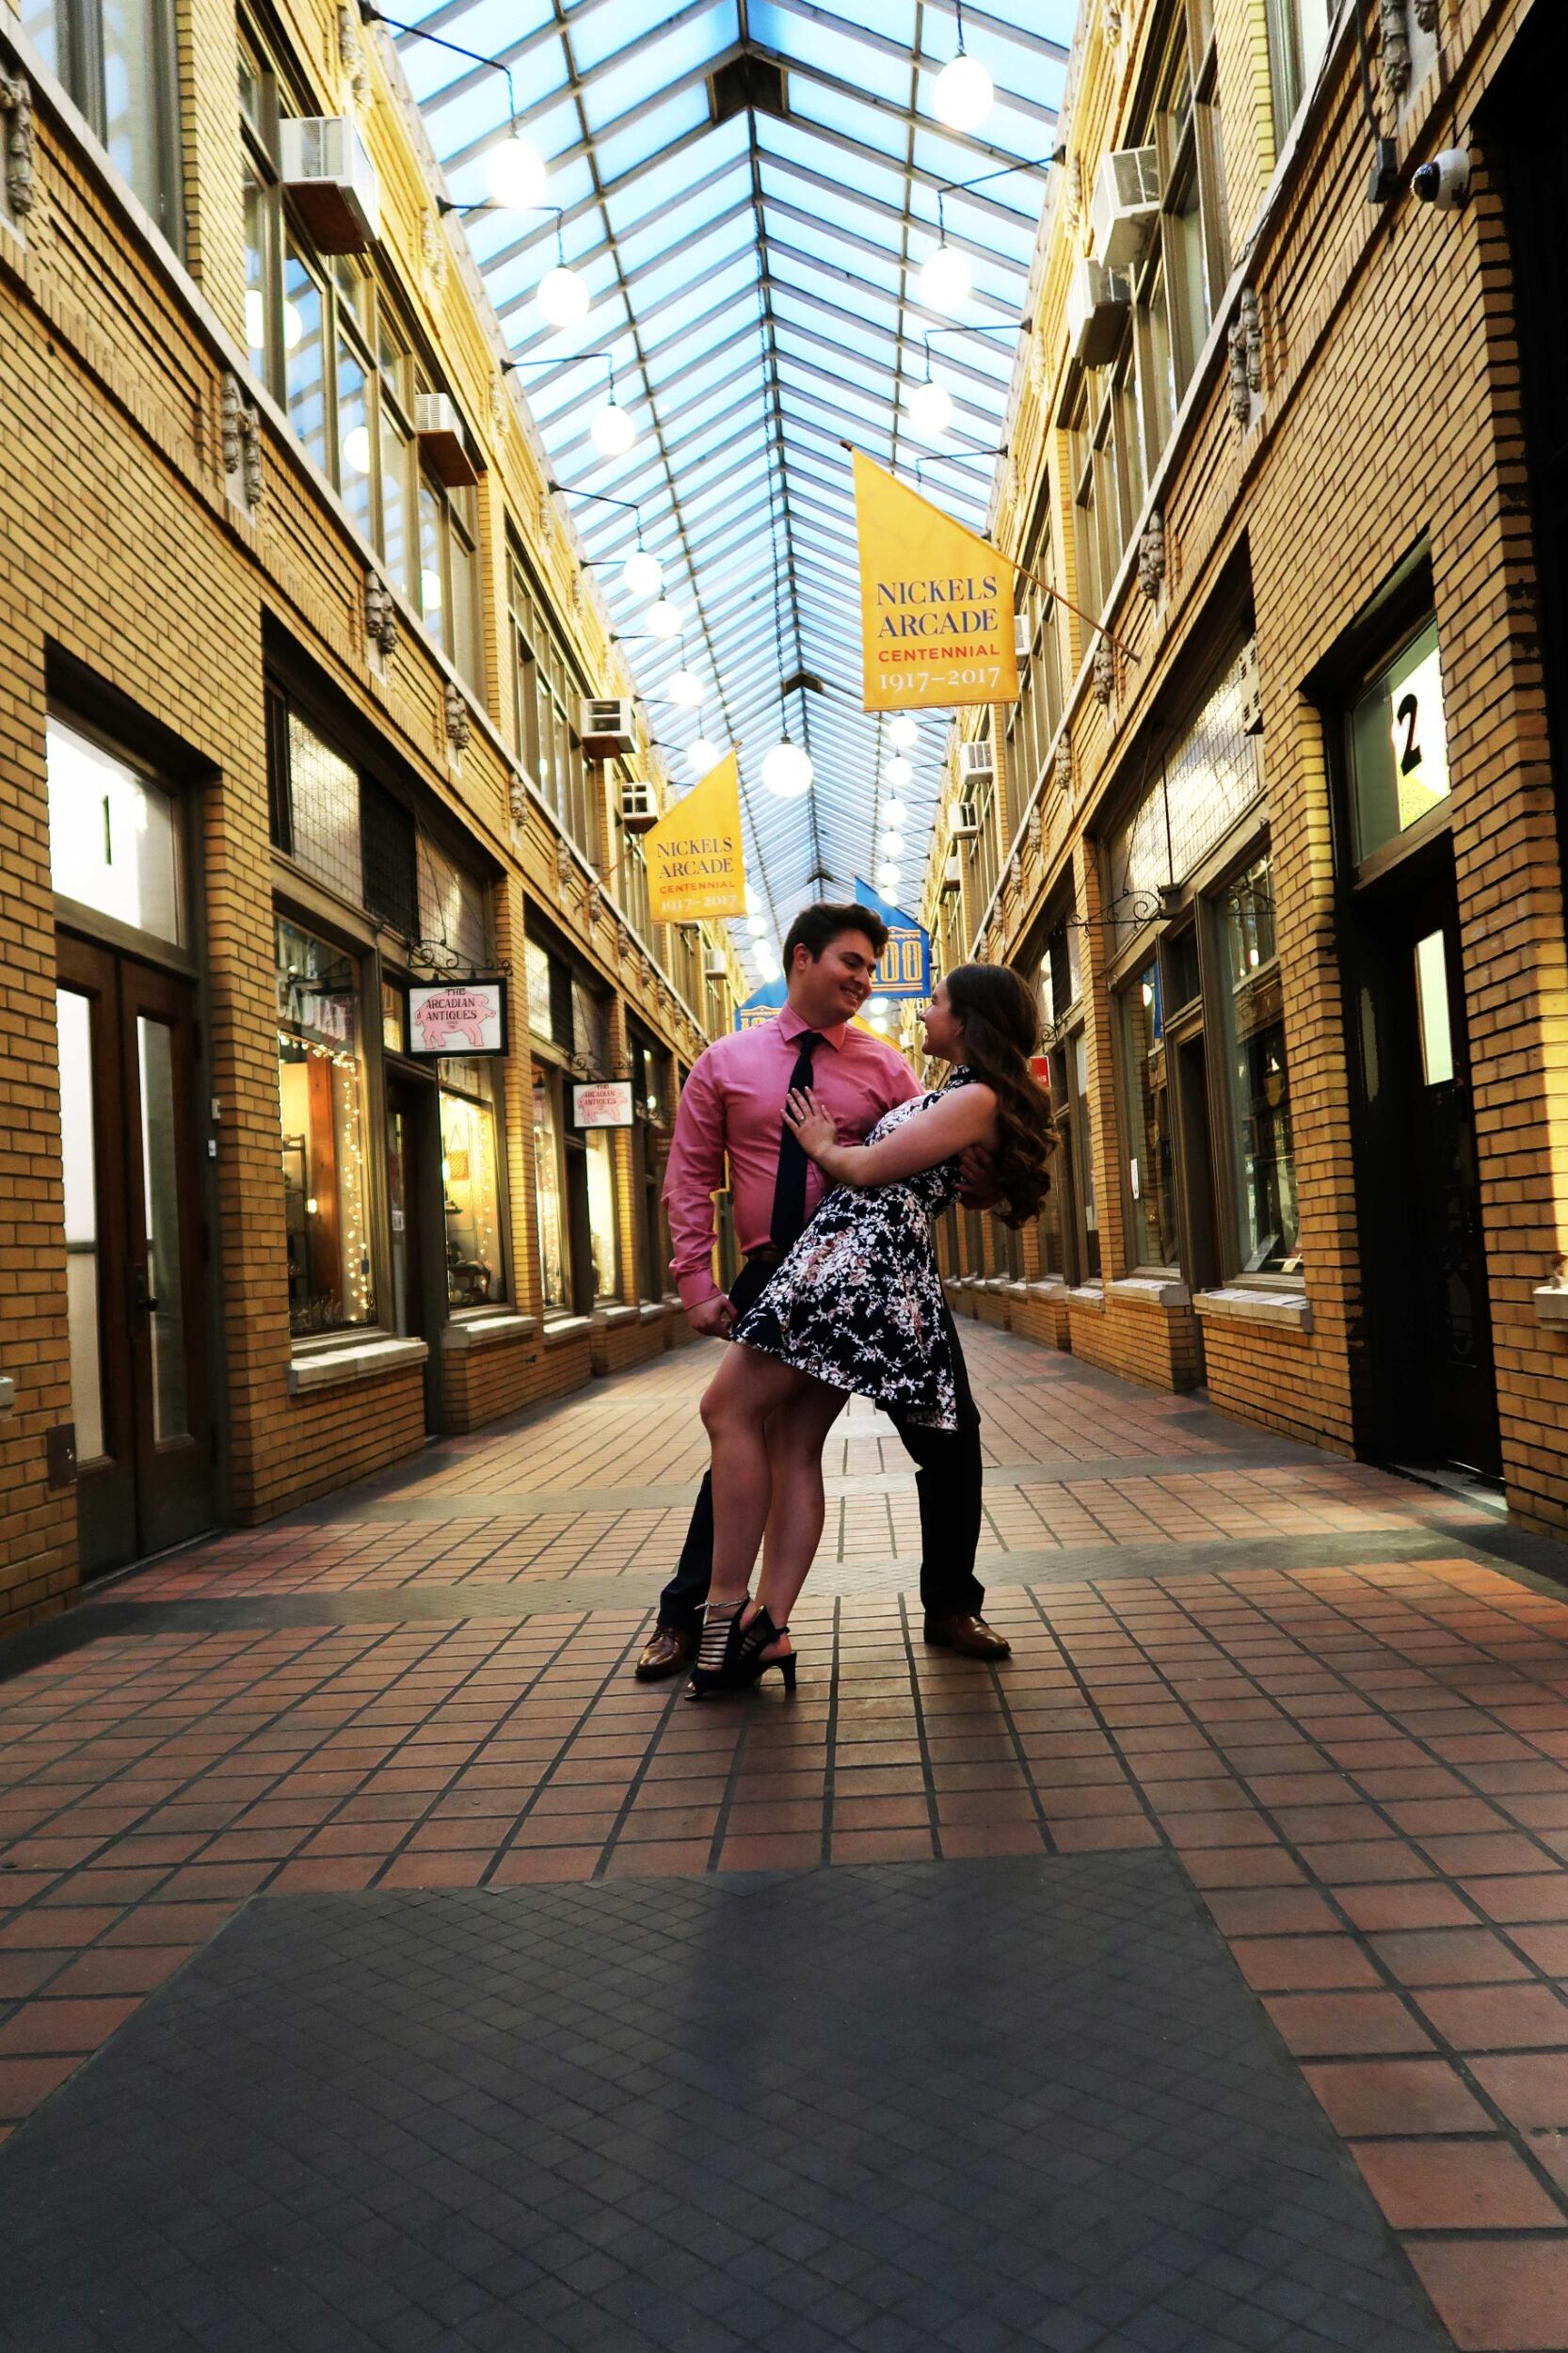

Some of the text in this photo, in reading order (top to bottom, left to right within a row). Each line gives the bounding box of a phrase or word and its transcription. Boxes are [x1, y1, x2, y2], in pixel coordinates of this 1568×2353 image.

[876, 575, 998, 605] NICKELS
[877, 608, 999, 638] ARCADE
[878, 644, 1000, 663] CENTENNIAL
[1397, 694, 1422, 776] 2
[657, 836, 732, 858] NICKELS
[659, 857, 734, 879] ARCADE
[660, 881, 736, 894] CENTENNIAL
[869, 940, 922, 982] 00
[445, 987, 466, 996] THE
[425, 997, 475, 1009] ARCADIAN
[425, 1010, 477, 1021] ANTIQUES
